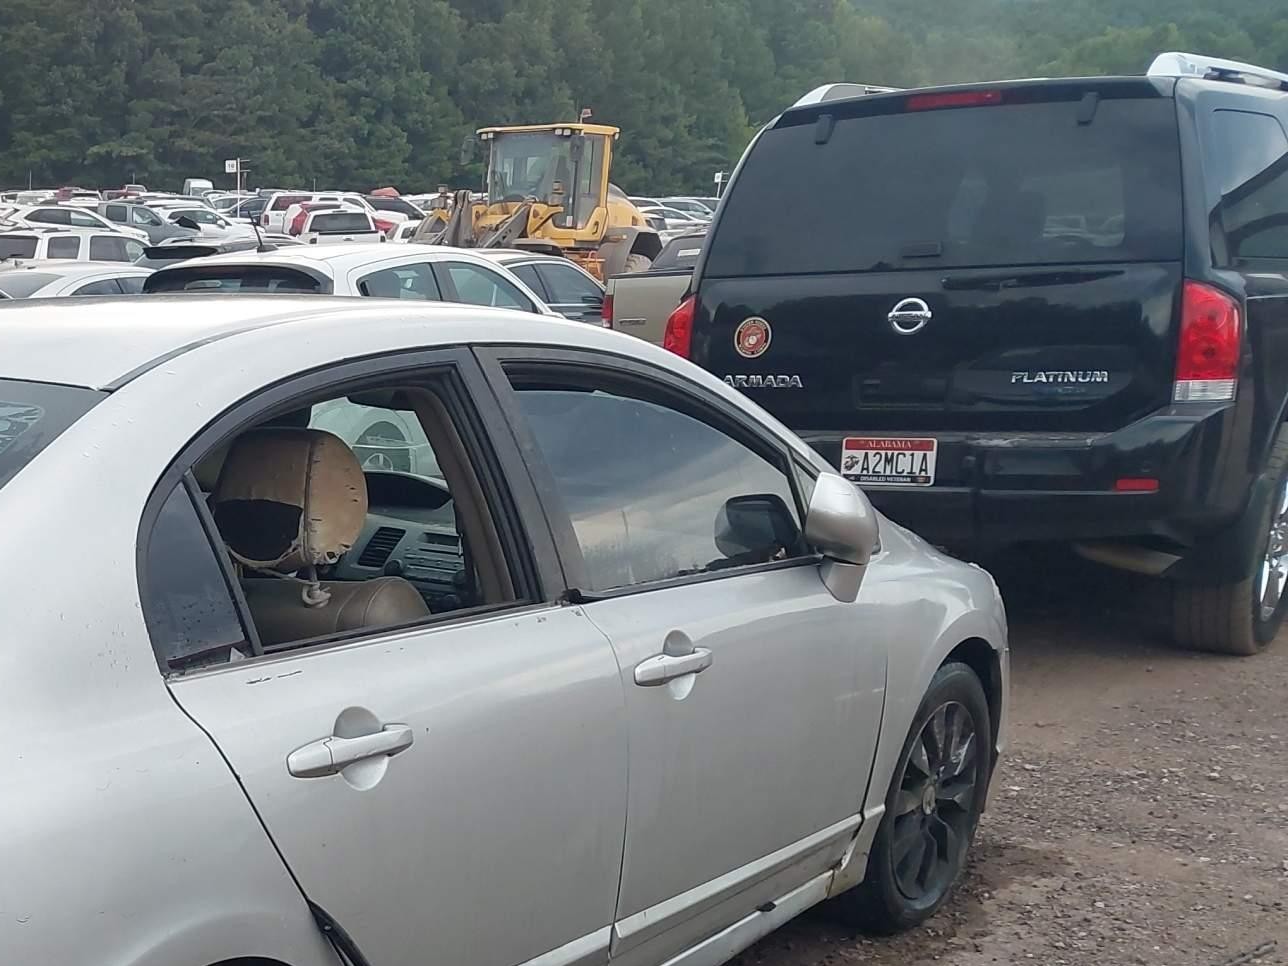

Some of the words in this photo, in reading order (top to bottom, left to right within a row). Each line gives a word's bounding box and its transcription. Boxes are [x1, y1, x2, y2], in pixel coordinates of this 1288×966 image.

[723, 374, 803, 388] ARMADA
[1011, 371, 1108, 383] PLATINUM
[866, 440, 912, 449] ALABAMA
[860, 452, 928, 475] A2MC1A
